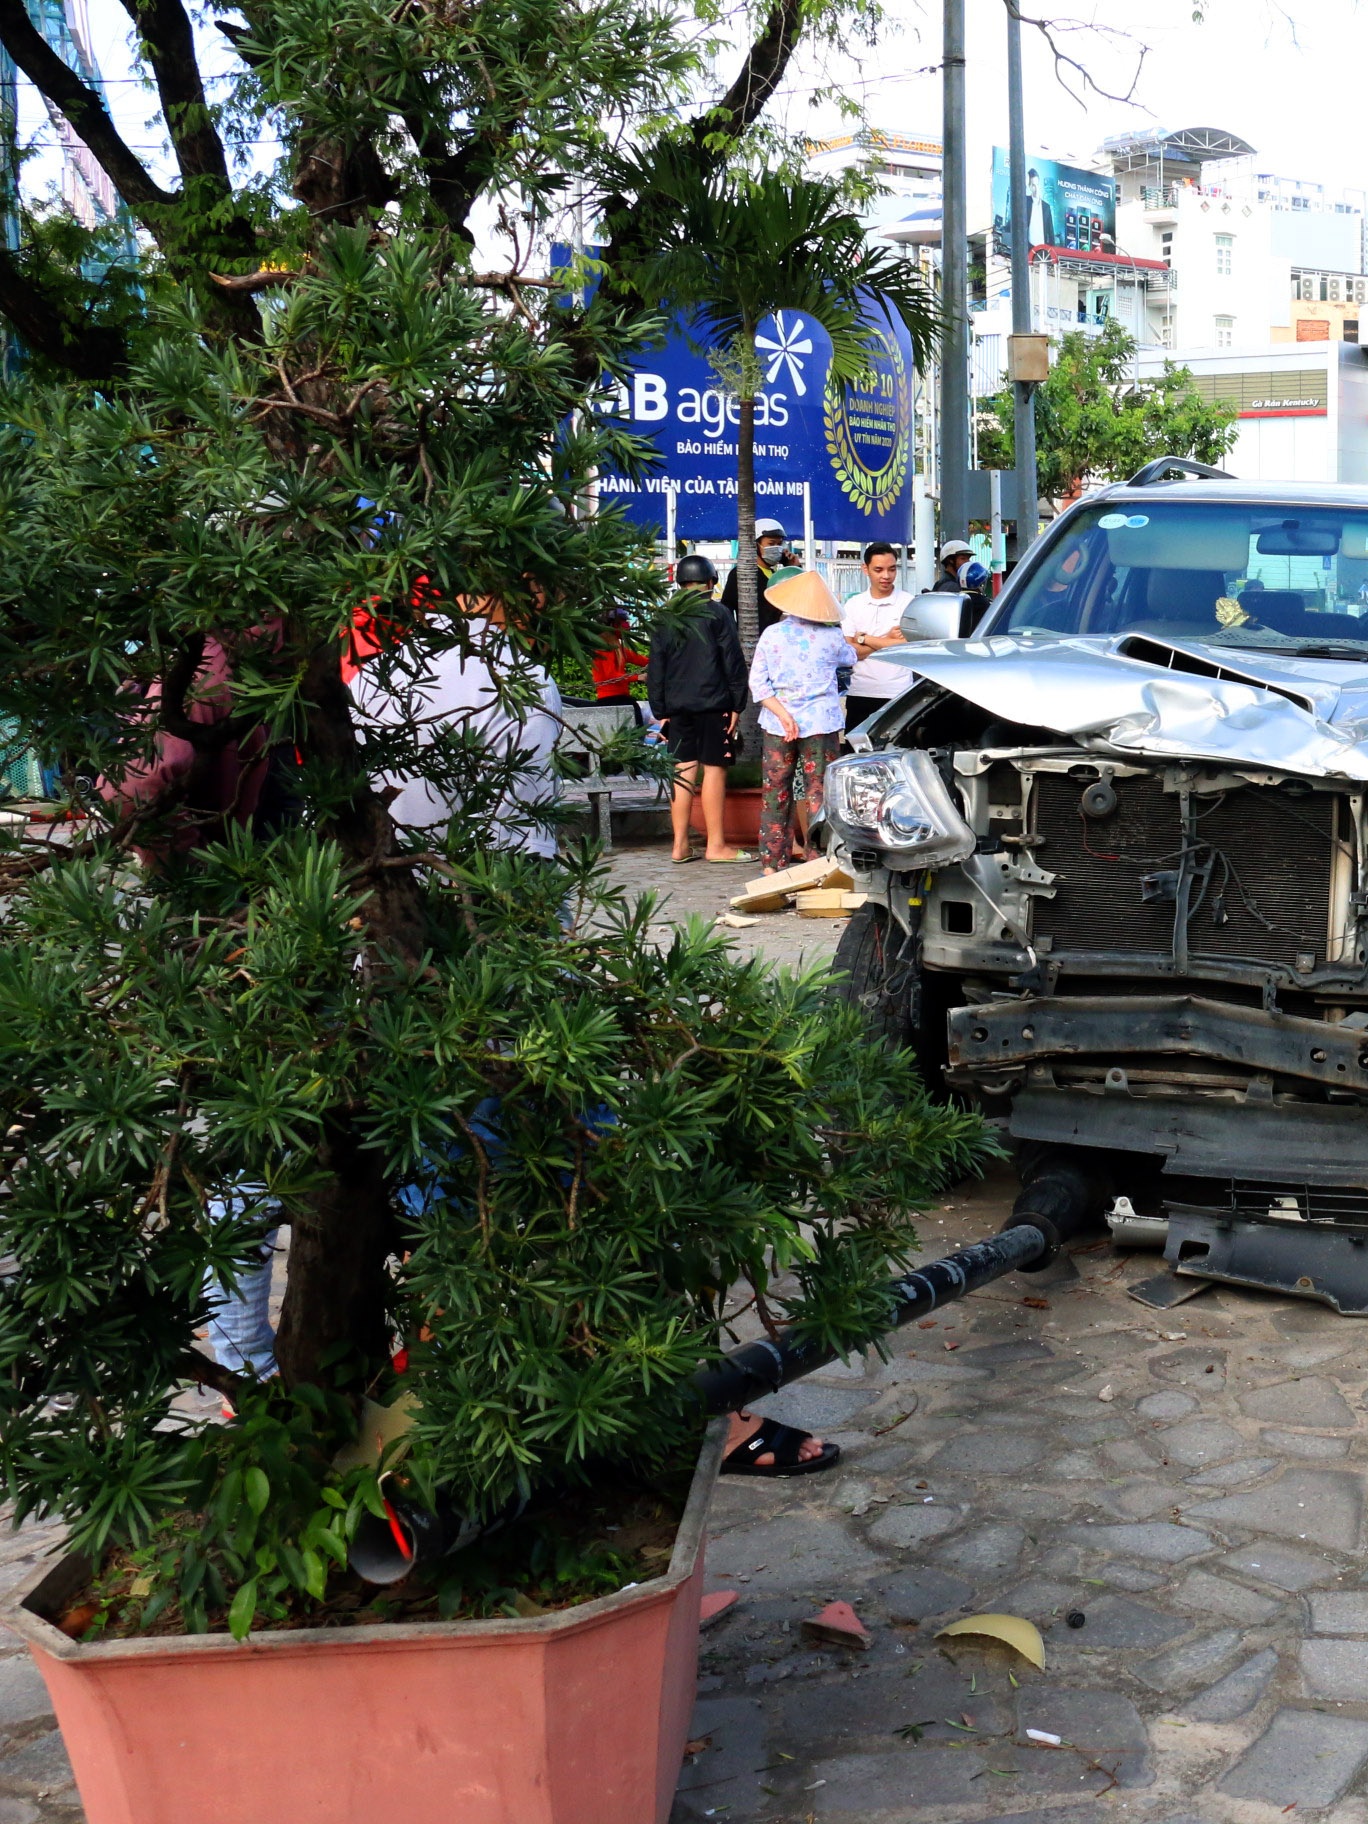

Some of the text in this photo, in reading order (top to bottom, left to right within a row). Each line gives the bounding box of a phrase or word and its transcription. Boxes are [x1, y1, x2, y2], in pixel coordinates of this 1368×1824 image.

[880, 373, 893, 398] 10
[677, 387, 789, 438] ageas
[849, 398, 873, 413] DOANH
[1252, 398, 1319, 408] Gà Rán Kentucky
[676, 438, 789, 460] BẢO HIỂM ÂN THỌ
[645, 475, 681, 494] VIÊN
[684, 475, 715, 495] CỦA
[786, 481, 804, 496] MB
